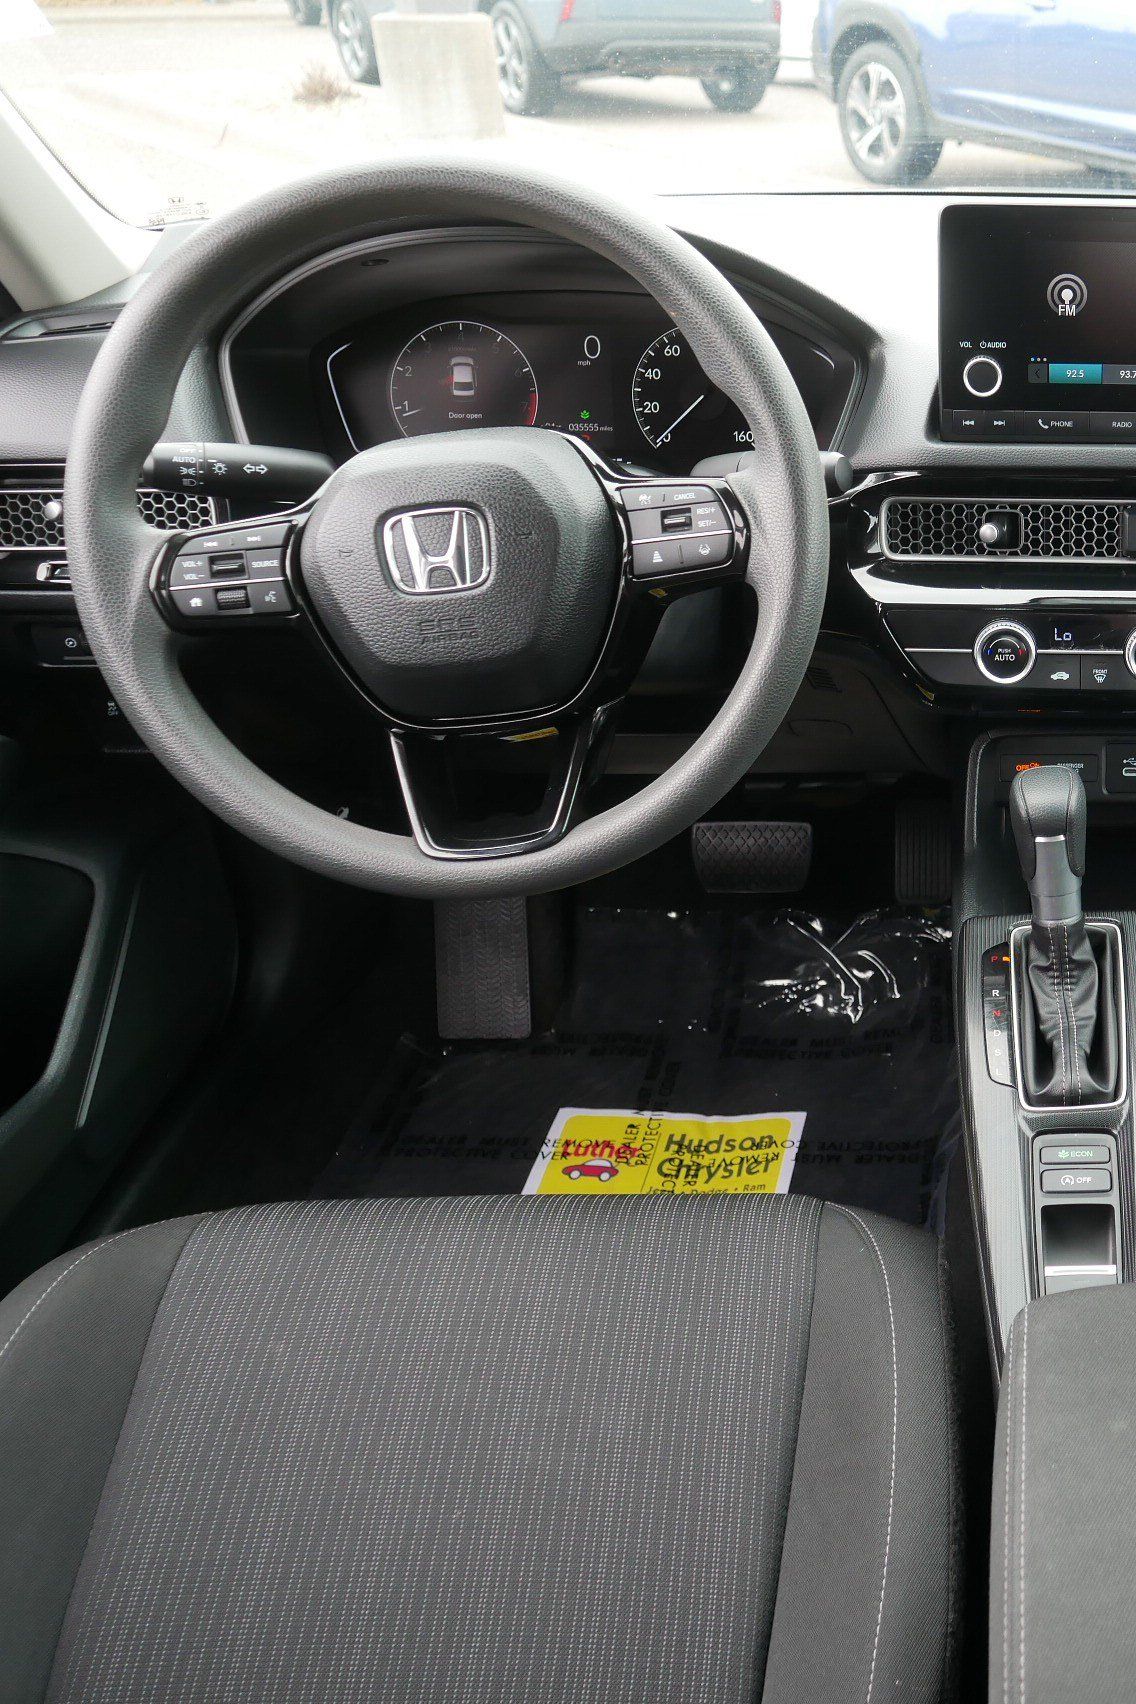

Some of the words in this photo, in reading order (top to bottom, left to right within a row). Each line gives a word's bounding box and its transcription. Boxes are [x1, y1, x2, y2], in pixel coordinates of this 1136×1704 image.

[1058, 304, 1076, 316] FM
[584, 335, 601, 359] 0
[664, 344, 681, 357] 60
[404, 366, 413, 377] 2
[644, 368, 662, 380] 40
[1066, 369, 1085, 378] 92.5
[643, 402, 660, 413] 20
[466, 413, 483, 421] open
[568, 423, 598, 432] 035555
[599, 424, 613, 432] miles
[1050, 420, 1074, 428] PHONE
[1112, 420, 1133, 429] RADIO
[733, 431, 754, 442] 160
[673, 492, 696, 501] CANCEL
[251, 560, 279, 568] SOURCE
[1054, 627, 1073, 641] Lo
[994, 654, 1016, 662] AUTO
[992, 989, 1000, 997] R
[996, 1068, 1002, 1076] L
[664, 1134, 775, 1154] Hudson
[563, 1138, 642, 1160] Luther
[1070, 1150, 1093, 1158] ECON
[657, 1156, 772, 1184] Chrysler
[1076, 1176, 1092, 1184] OFF
[743, 1184, 766, 1192] Ram
